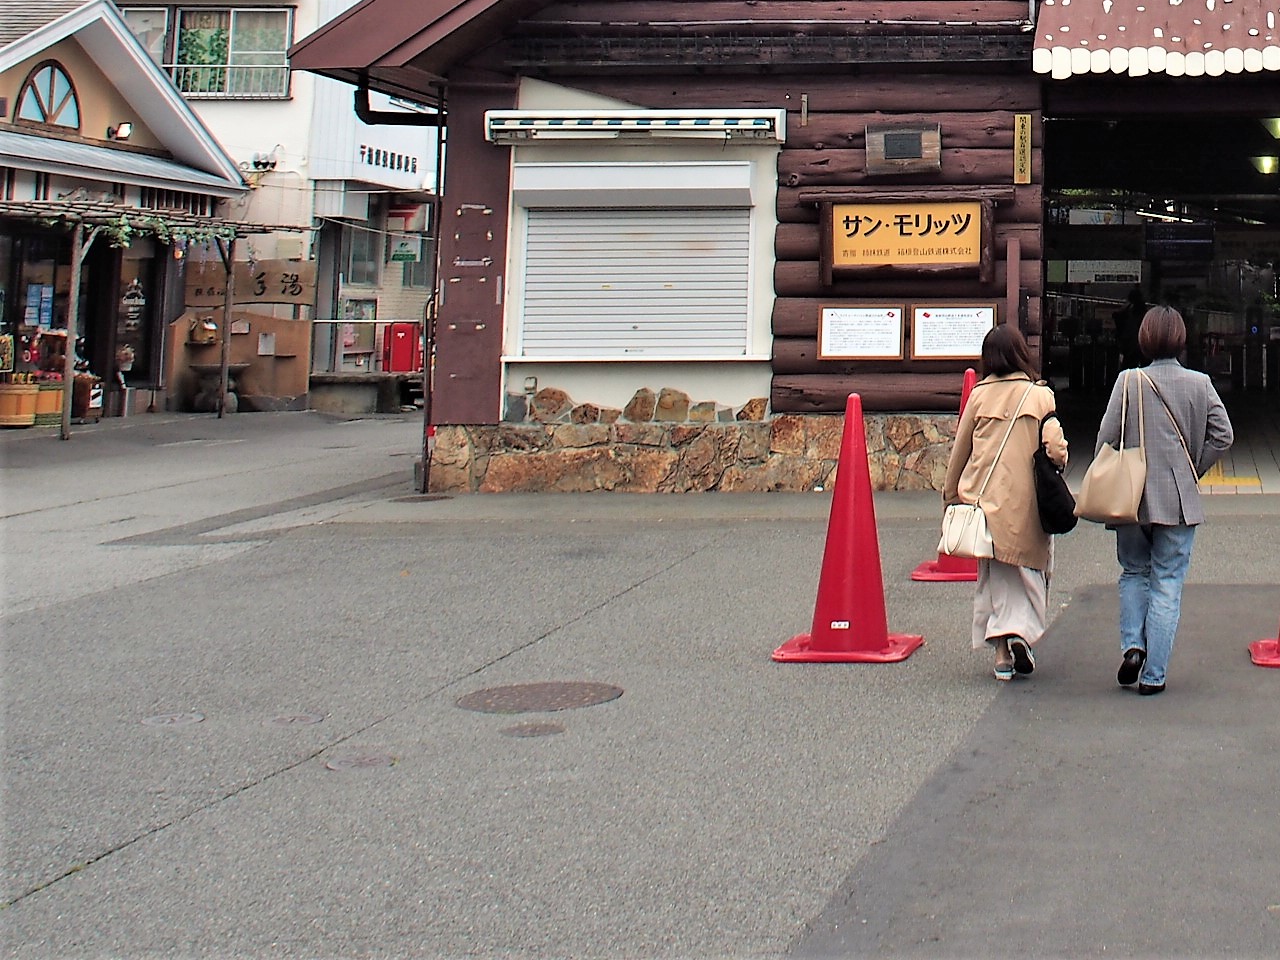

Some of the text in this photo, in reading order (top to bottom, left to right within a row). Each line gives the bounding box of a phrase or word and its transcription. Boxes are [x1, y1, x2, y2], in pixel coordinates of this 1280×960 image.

[842, 212, 972, 238] サン・モリッツ
